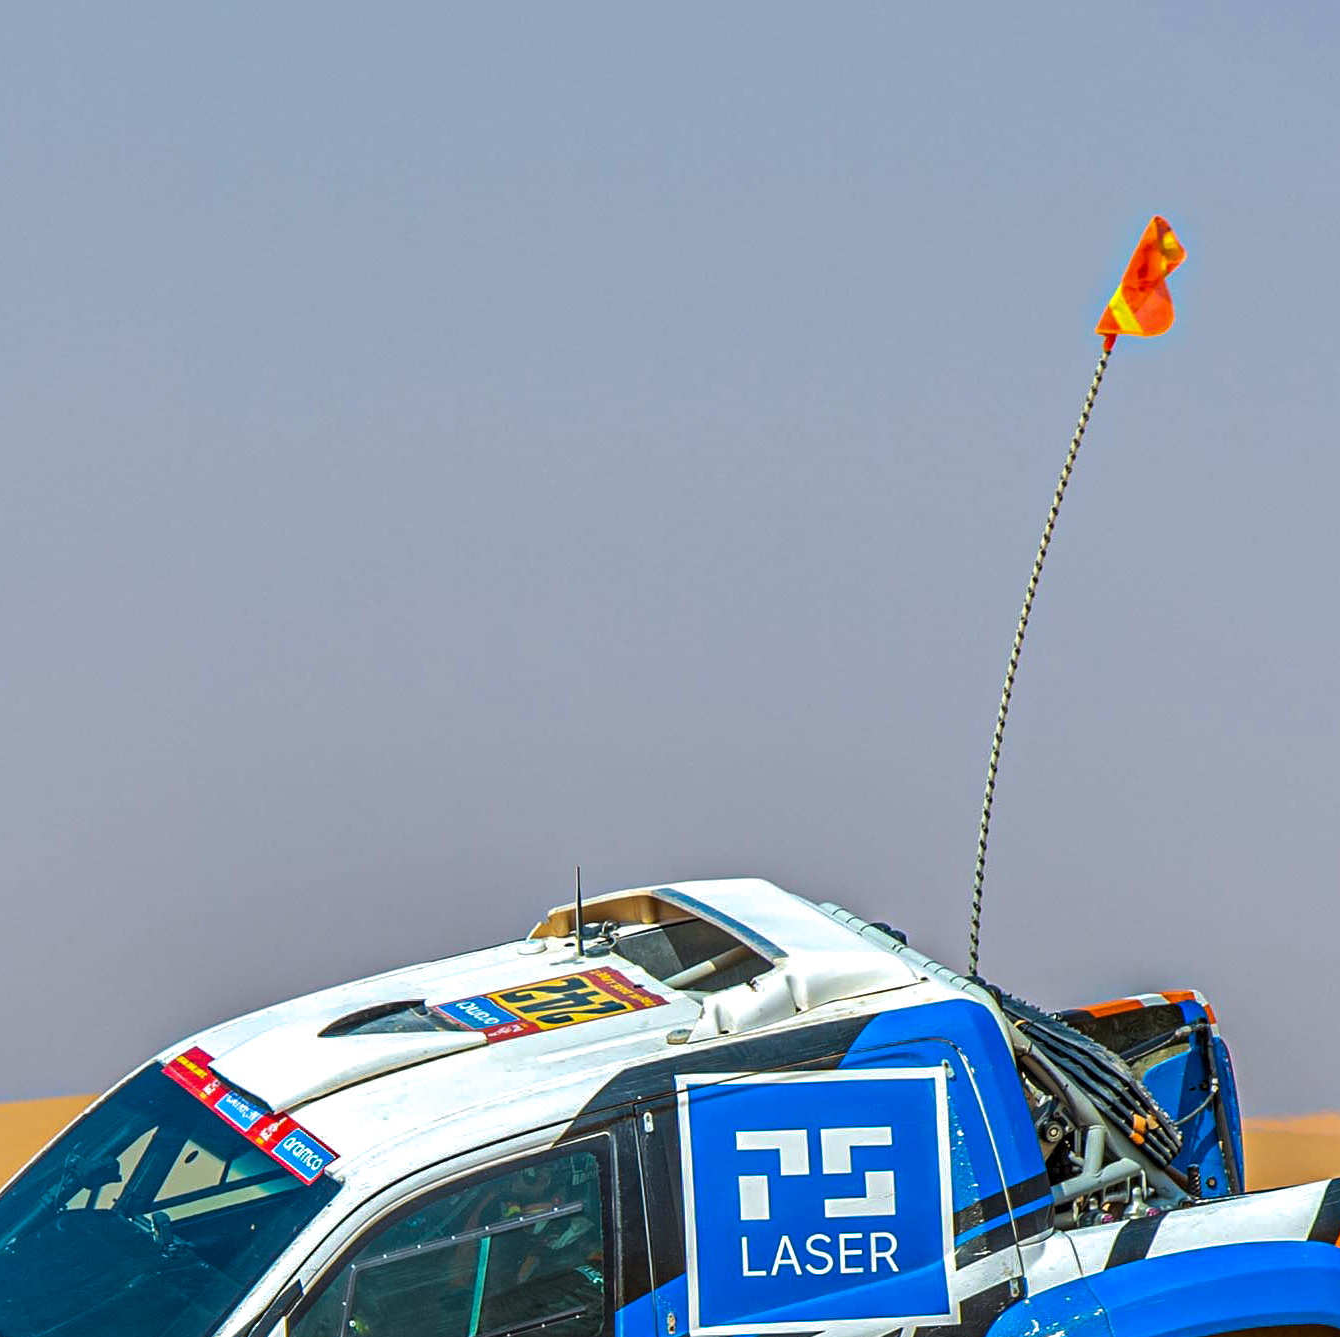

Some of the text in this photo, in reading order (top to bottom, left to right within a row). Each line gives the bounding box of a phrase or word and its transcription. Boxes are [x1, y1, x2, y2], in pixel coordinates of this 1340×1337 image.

[497, 975, 627, 1025] 242
[282, 1136, 324, 1171] aramco
[741, 1231, 900, 1277] LASER
